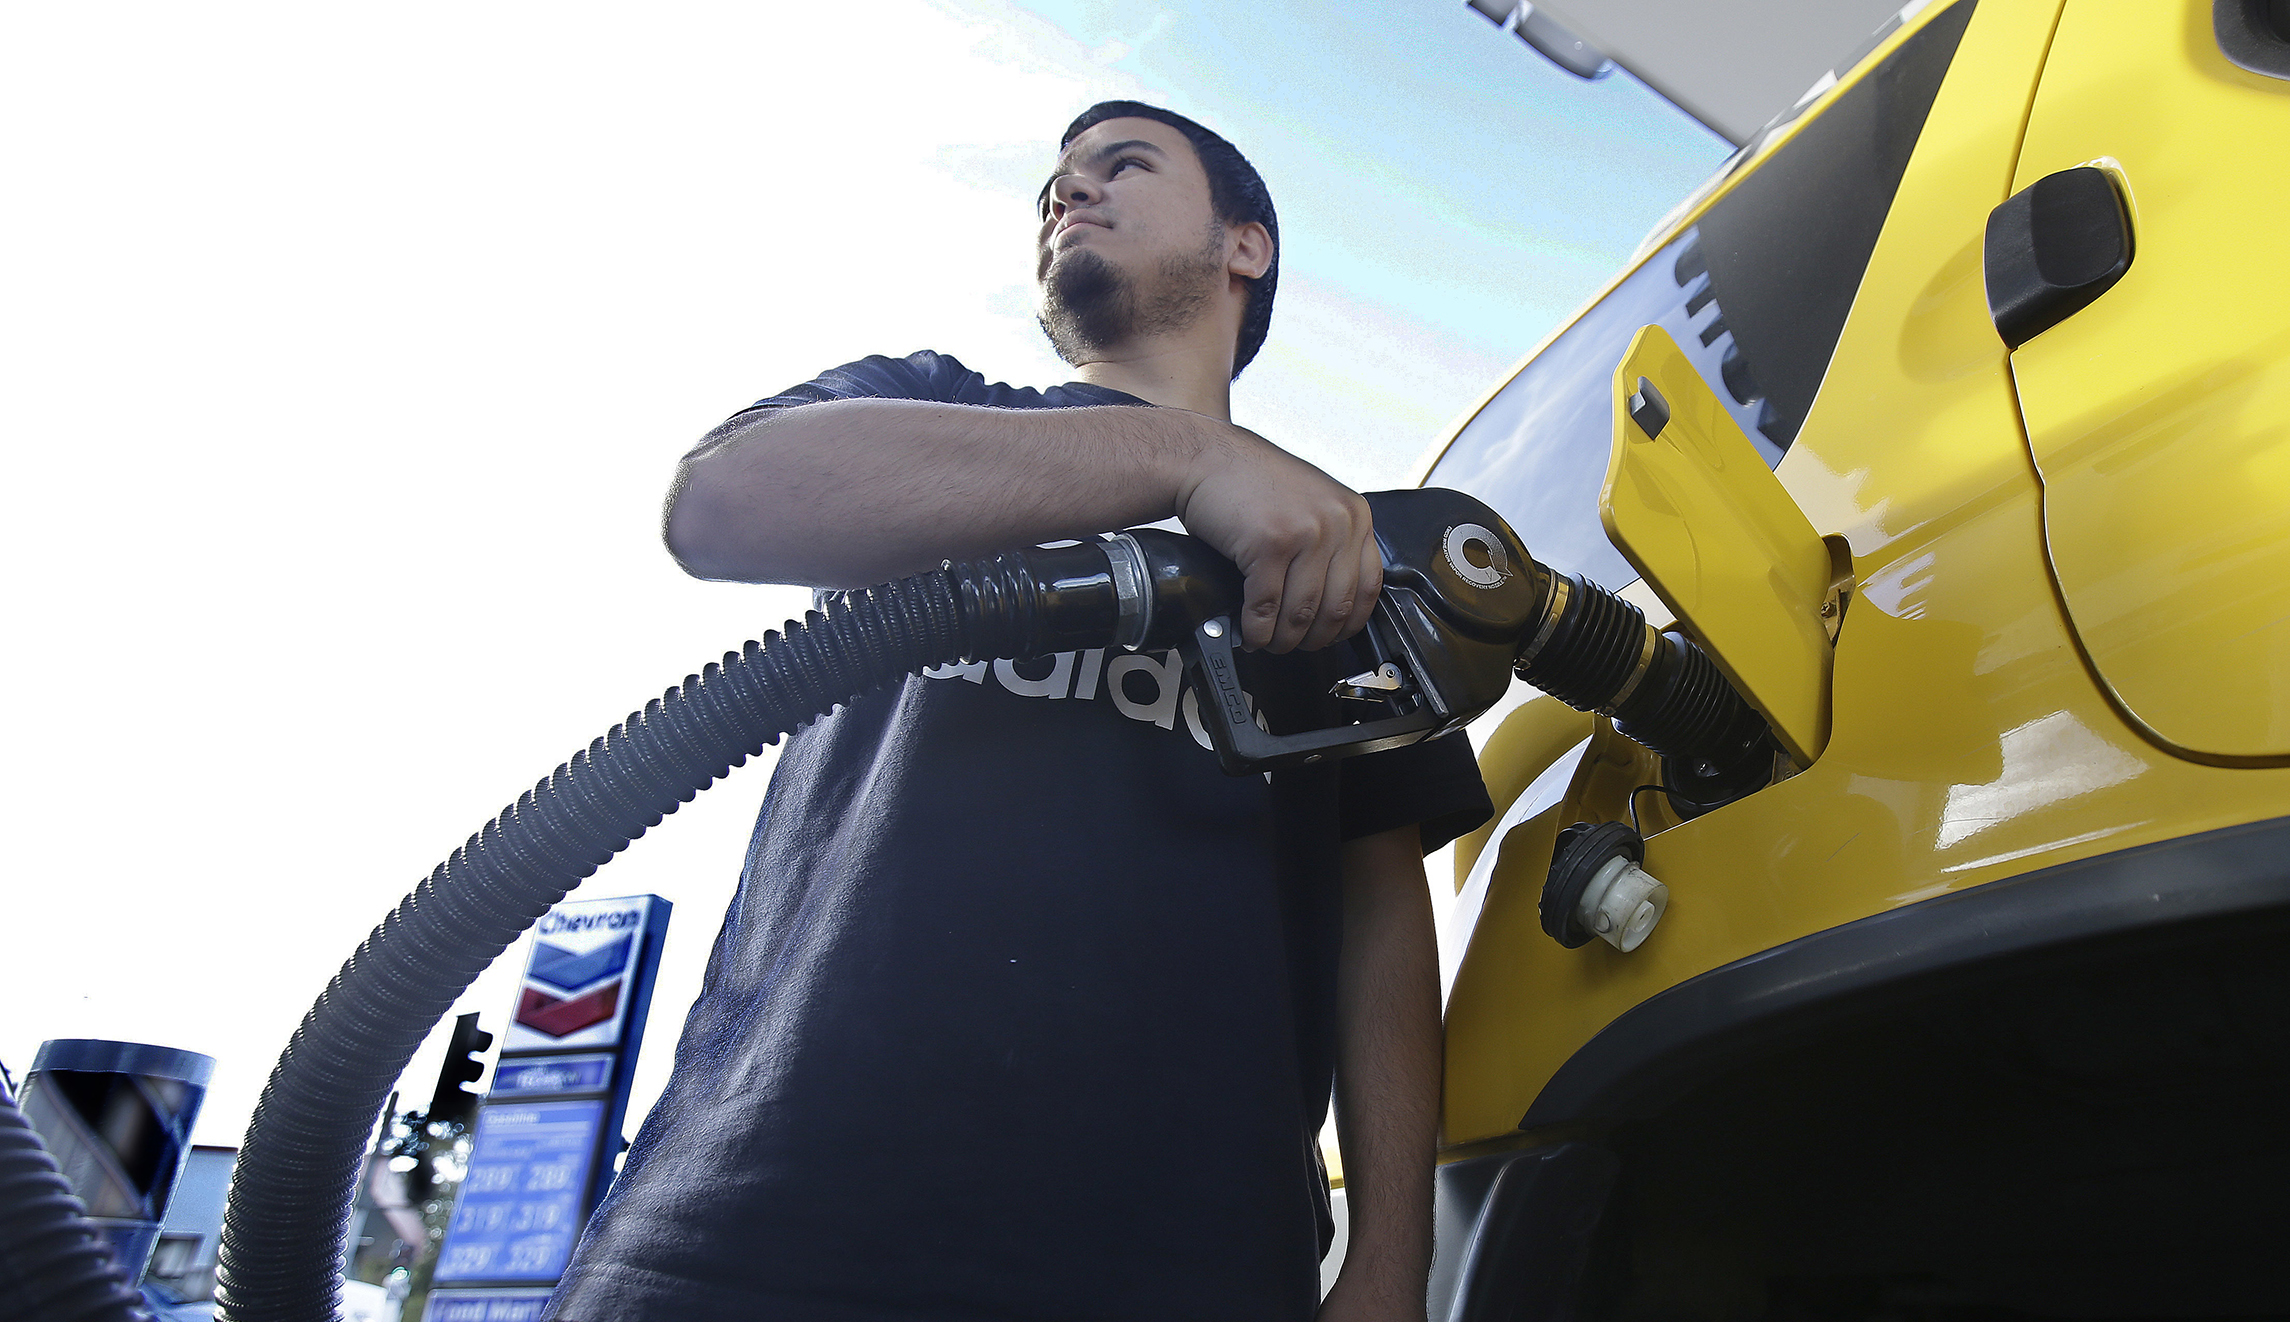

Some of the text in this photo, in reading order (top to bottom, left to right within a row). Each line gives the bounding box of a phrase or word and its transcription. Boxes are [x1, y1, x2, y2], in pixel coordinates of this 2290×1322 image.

[1449, 562, 1463, 579] VAPOR
[1461, 577, 1488, 590] RECOVERY
[539, 910, 641, 934] Chevron
